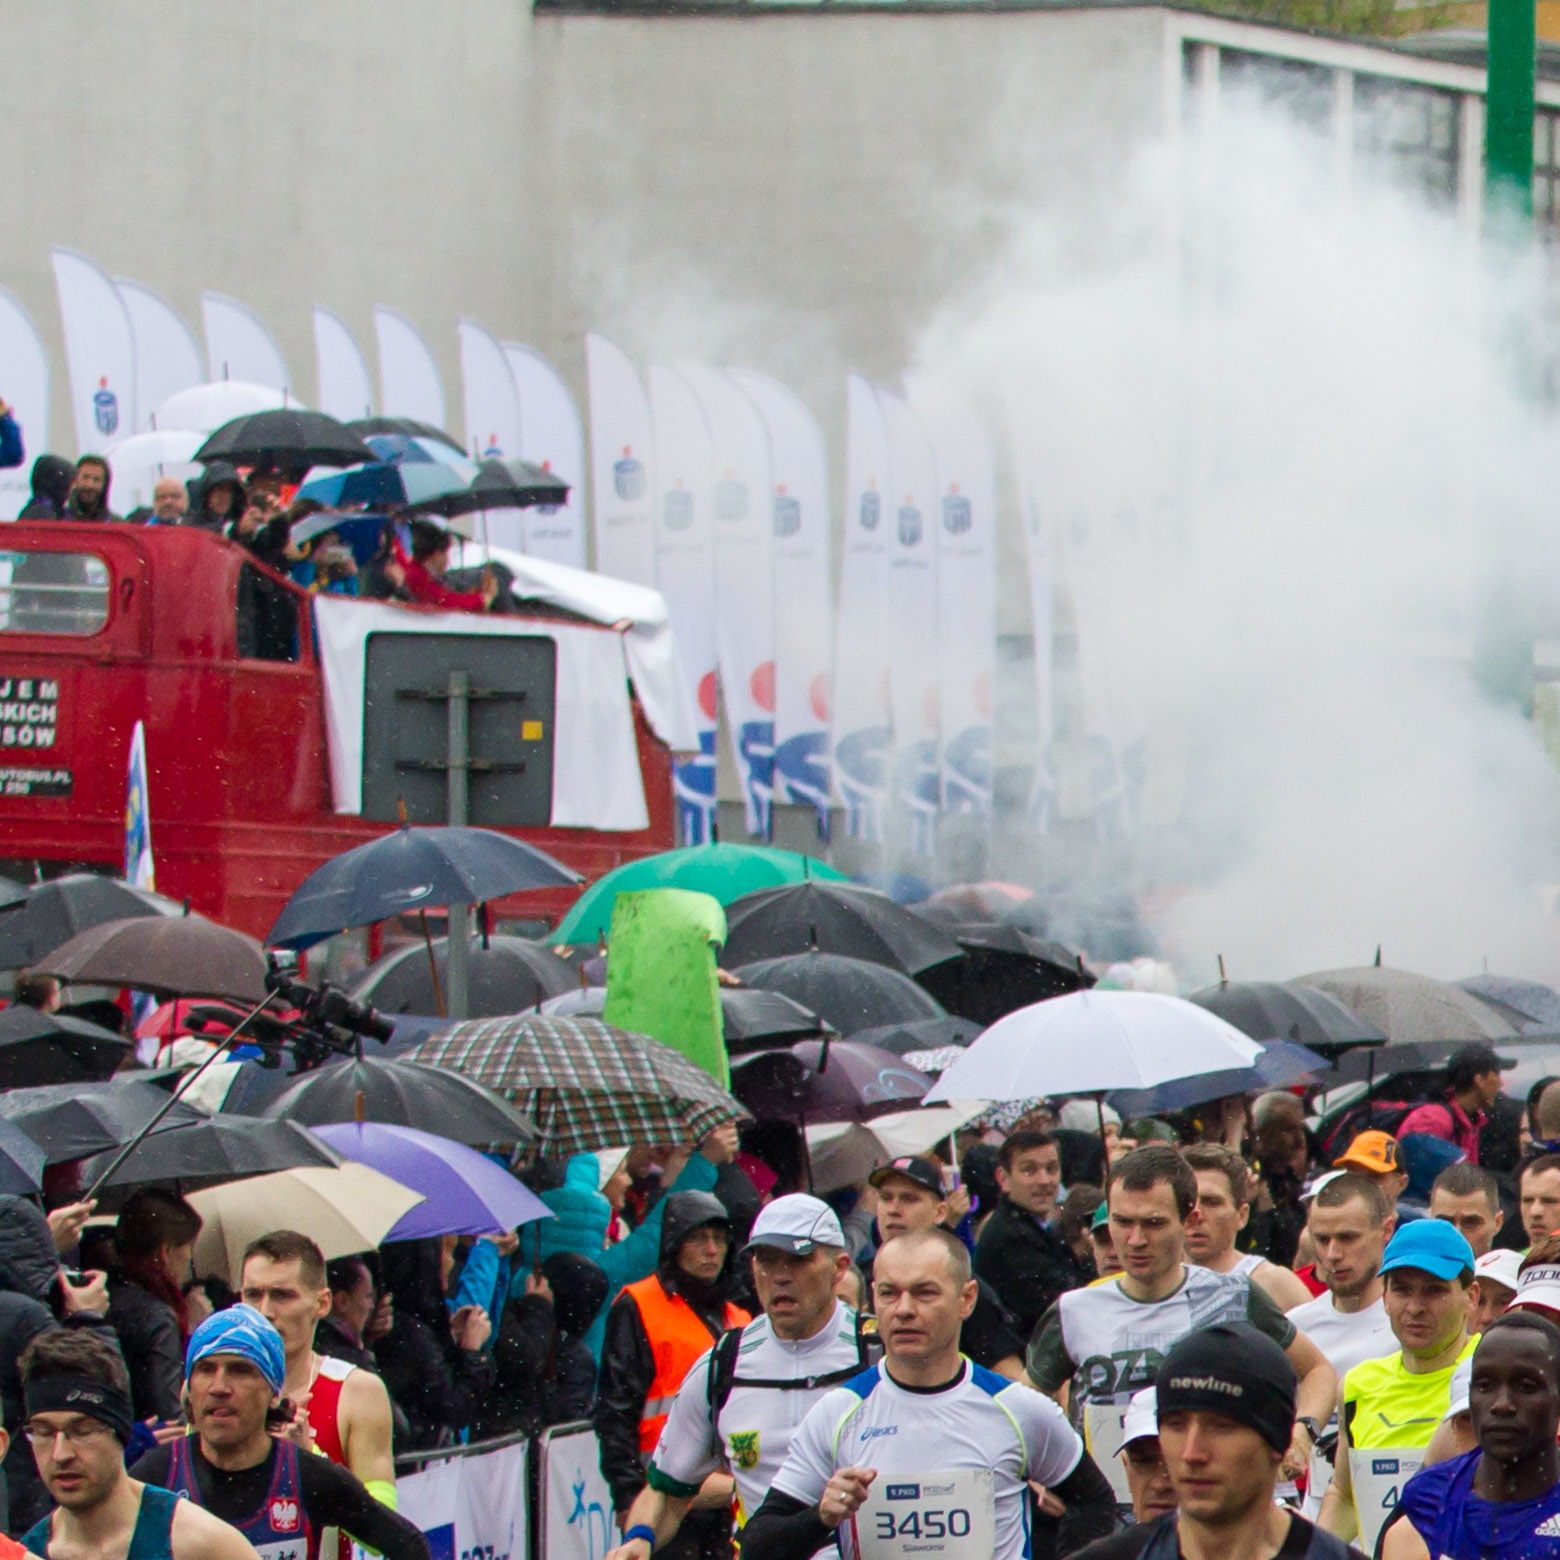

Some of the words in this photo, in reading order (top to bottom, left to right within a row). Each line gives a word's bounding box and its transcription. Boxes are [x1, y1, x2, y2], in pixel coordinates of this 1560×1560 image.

[0, 701, 57, 723] KICH
[1169, 1375, 1244, 1398] newline
[875, 1508, 971, 1539] 3450
